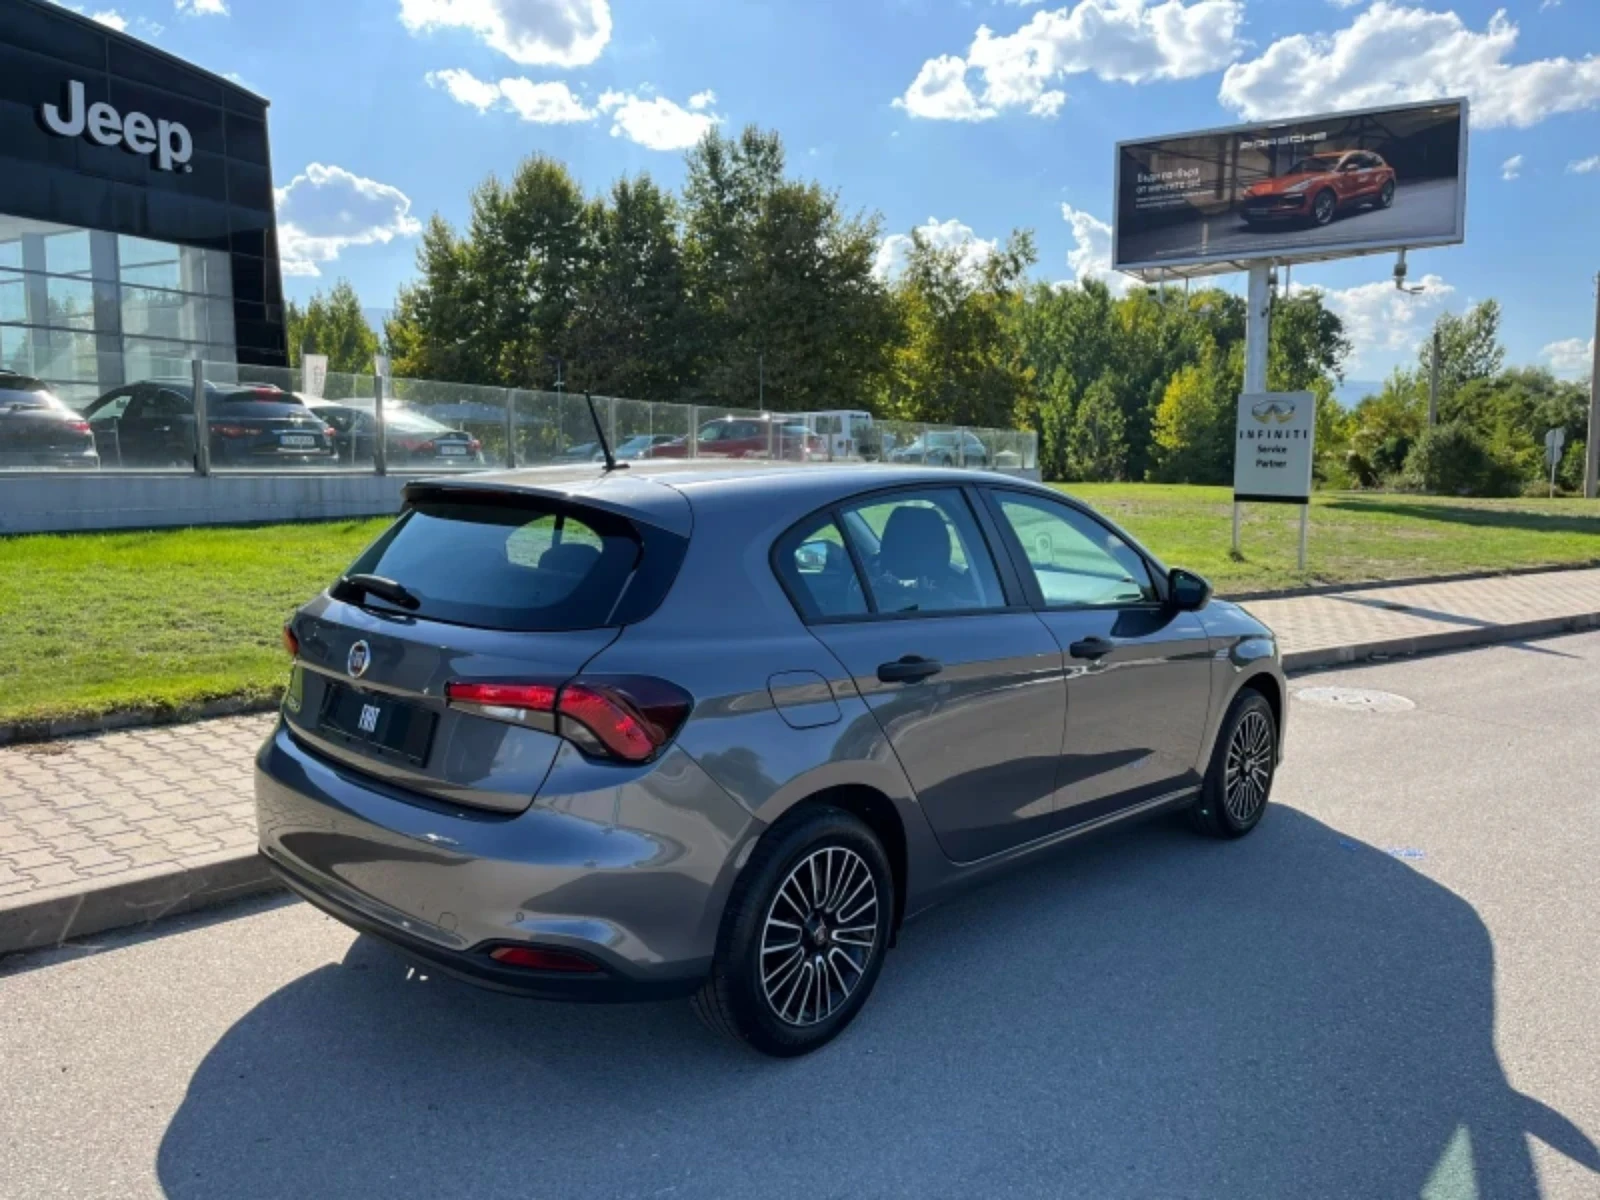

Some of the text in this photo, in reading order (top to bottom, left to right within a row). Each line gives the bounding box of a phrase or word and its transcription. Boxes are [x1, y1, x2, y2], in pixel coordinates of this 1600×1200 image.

[42, 79, 193, 172] Jeep
[1239, 429, 1308, 440] INFINITI
[1257, 444, 1288, 454] Service
[1256, 459, 1287, 468] Partner
